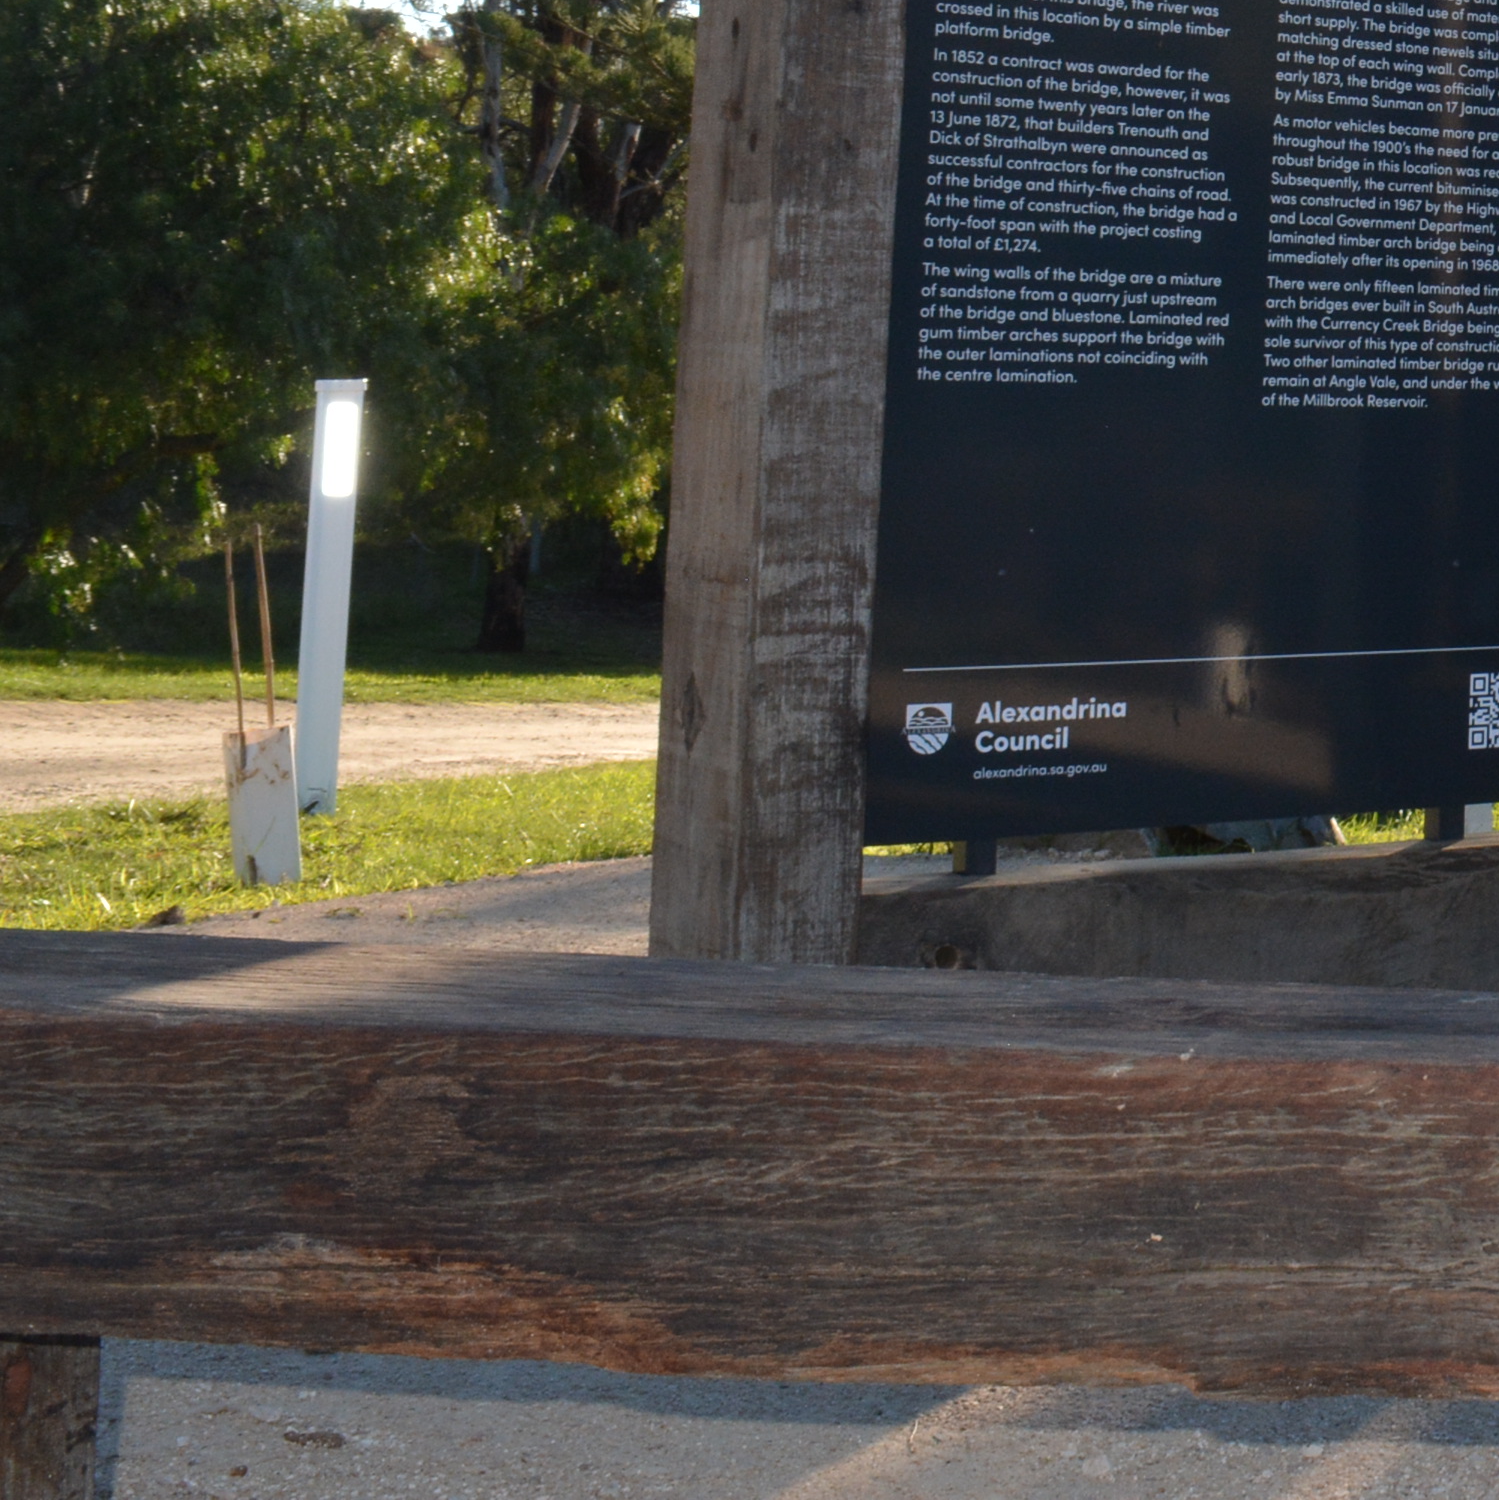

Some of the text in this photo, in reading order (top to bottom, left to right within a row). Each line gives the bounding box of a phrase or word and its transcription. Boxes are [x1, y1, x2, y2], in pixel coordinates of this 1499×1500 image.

[935, 19, 1054, 45] platform bridge.
[1278, 31, 1339, 51] matching
[1342, 34, 1392, 52] dressed
[1396, 40, 1429, 55] stone
[1433, 45, 1474, 59] newels
[928, 153, 1225, 181] successful contractors for the construction
[1271, 170, 1361, 192] Subsequently,
[1365, 176, 1385, 191] the
[1388, 181, 1433, 193] current
[1269, 210, 1296, 225] and
[1300, 211, 1333, 226] Local
[1337, 213, 1416, 230] Government
[1419, 217, 1496, 236] Department,
[923, 234, 1041, 253] a total of £1,274.
[918, 344, 1208, 369] the outer laminations not coinciding with
[917, 365, 1077, 383] the centre lamination.
[1261, 391, 1428, 408] of the Millbrook Reservoir.
[975, 697, 1127, 724] Alexandrina
[975, 726, 1069, 754] Council
[973, 762, 1108, 780] alexandrina.sa.gov.au
